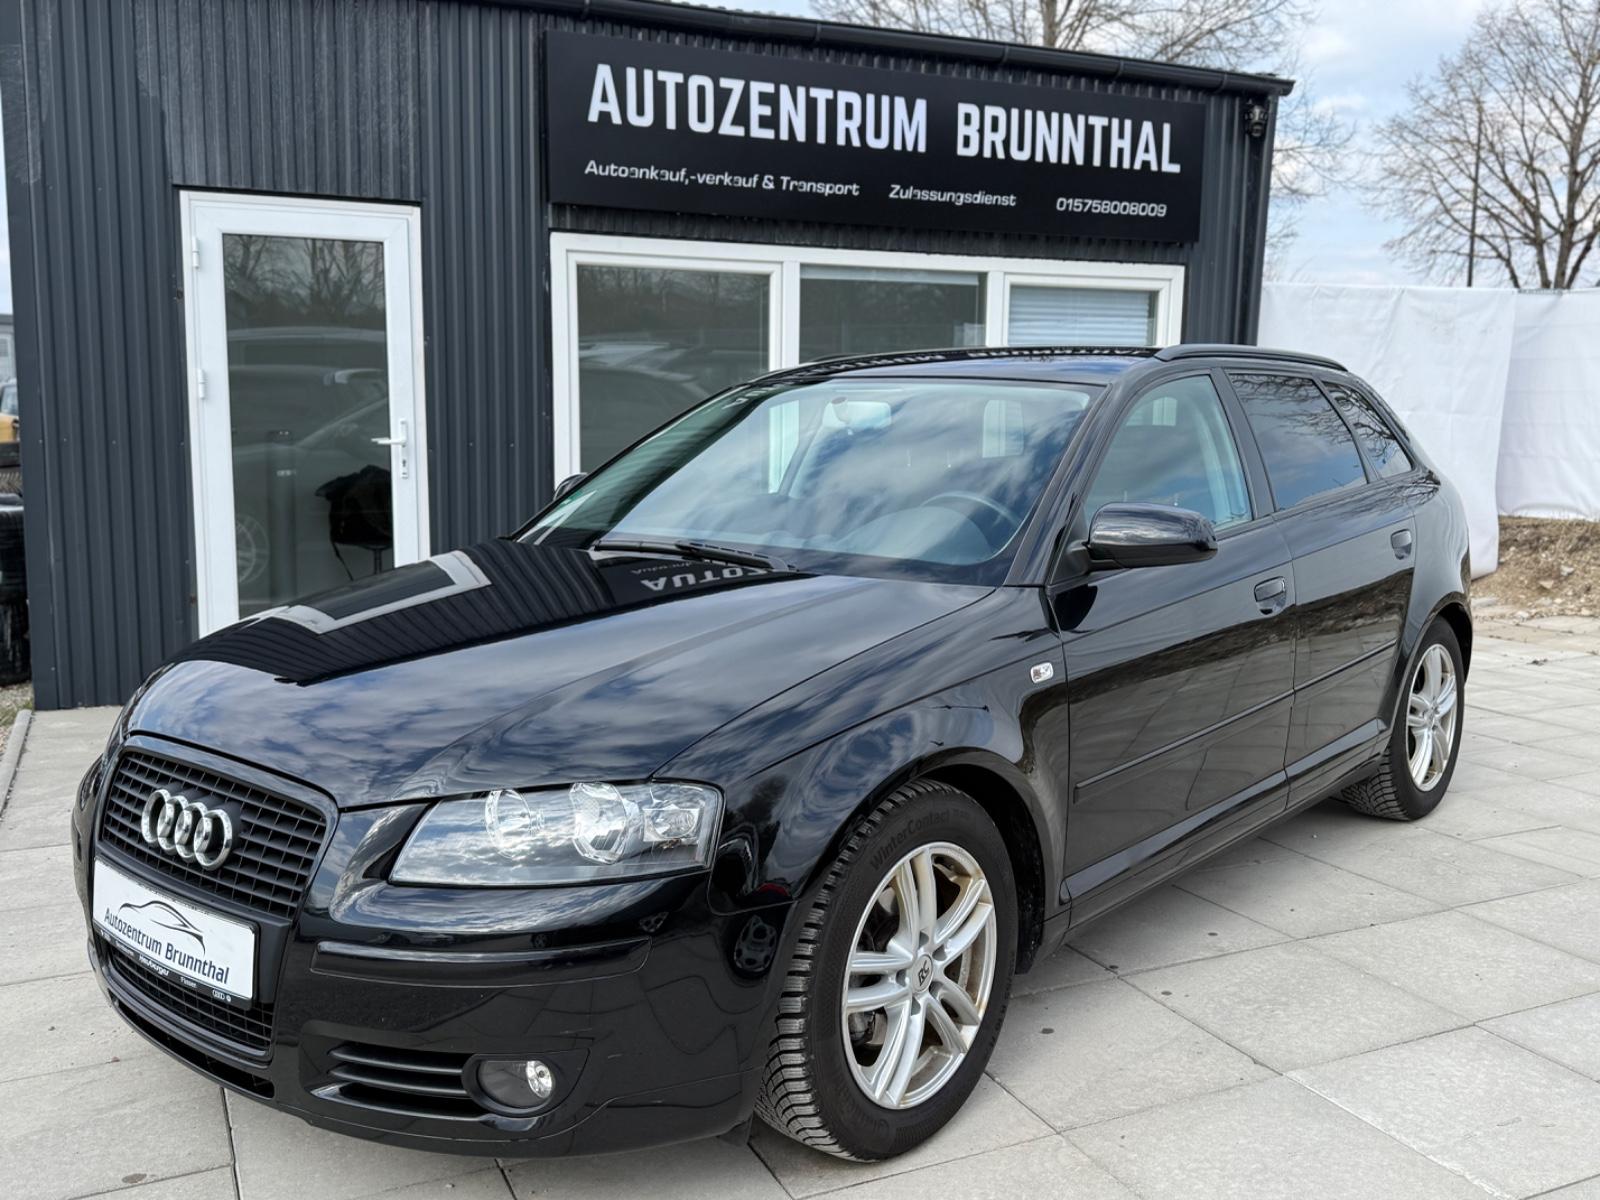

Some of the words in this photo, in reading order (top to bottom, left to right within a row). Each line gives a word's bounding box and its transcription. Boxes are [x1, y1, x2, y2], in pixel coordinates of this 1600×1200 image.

[587, 63, 927, 153] AUTOZENTRUM
[957, 102, 1181, 173] BRUNNTHAL
[762, 175, 775, 189] &
[780, 176, 860, 196] Transport
[889, 184, 1017, 206] Zulassungsdienst
[1056, 197, 1167, 217] 015758008009
[870, 810, 950, 870] WinterContact
[104, 907, 162, 956] Autozentrum
[165, 943, 230, 985] Brunnthal
